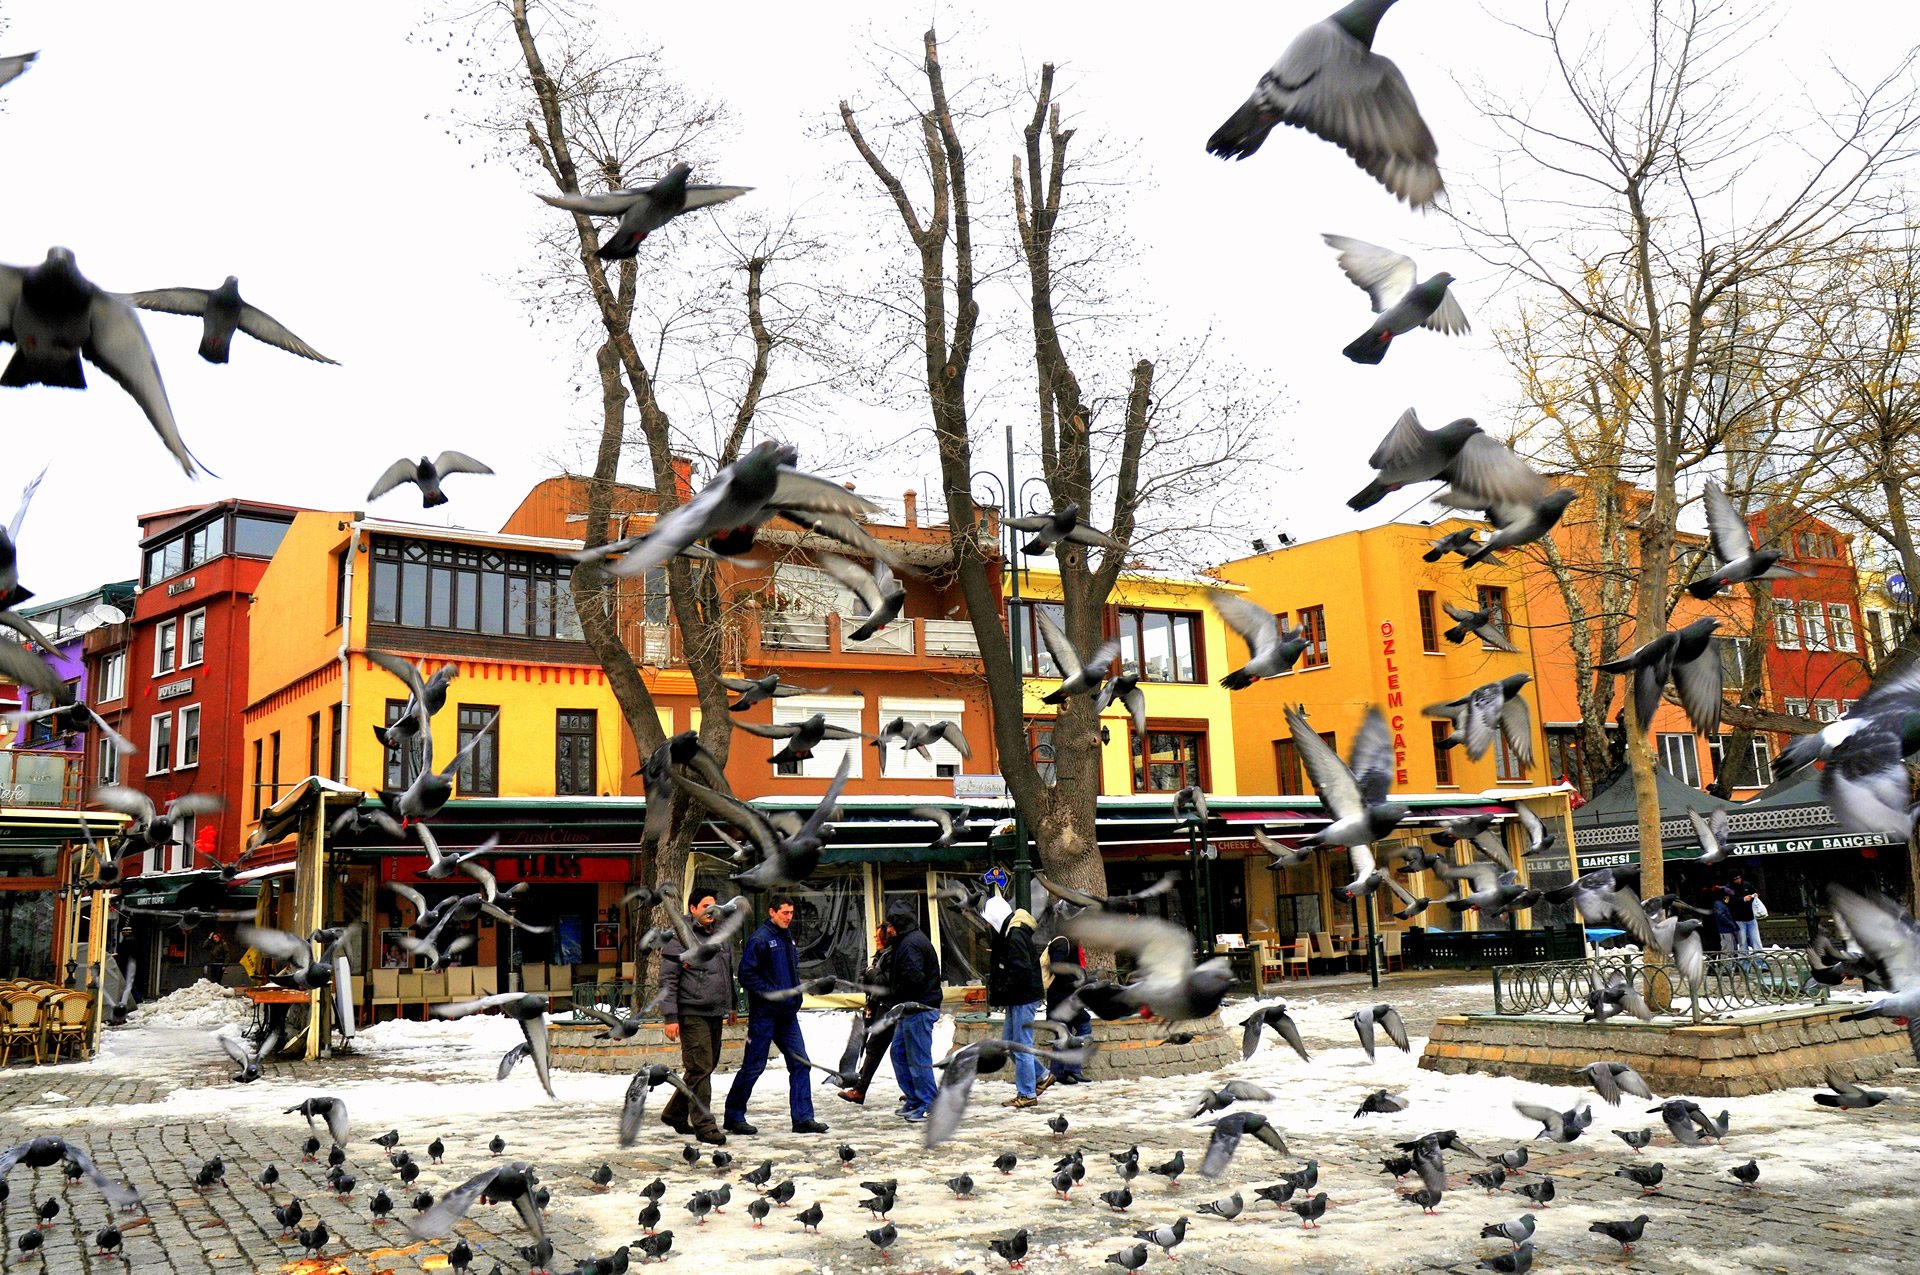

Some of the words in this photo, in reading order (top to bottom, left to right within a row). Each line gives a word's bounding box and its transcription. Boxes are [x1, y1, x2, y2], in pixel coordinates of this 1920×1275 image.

[1391, 715, 1408, 785] CAFE
[1218, 841, 1249, 850] CHEESE
[1527, 861, 1551, 871] ZLEM
[1556, 860, 1571, 871] ÇA
[1583, 853, 1630, 867] BAHÇESİ
